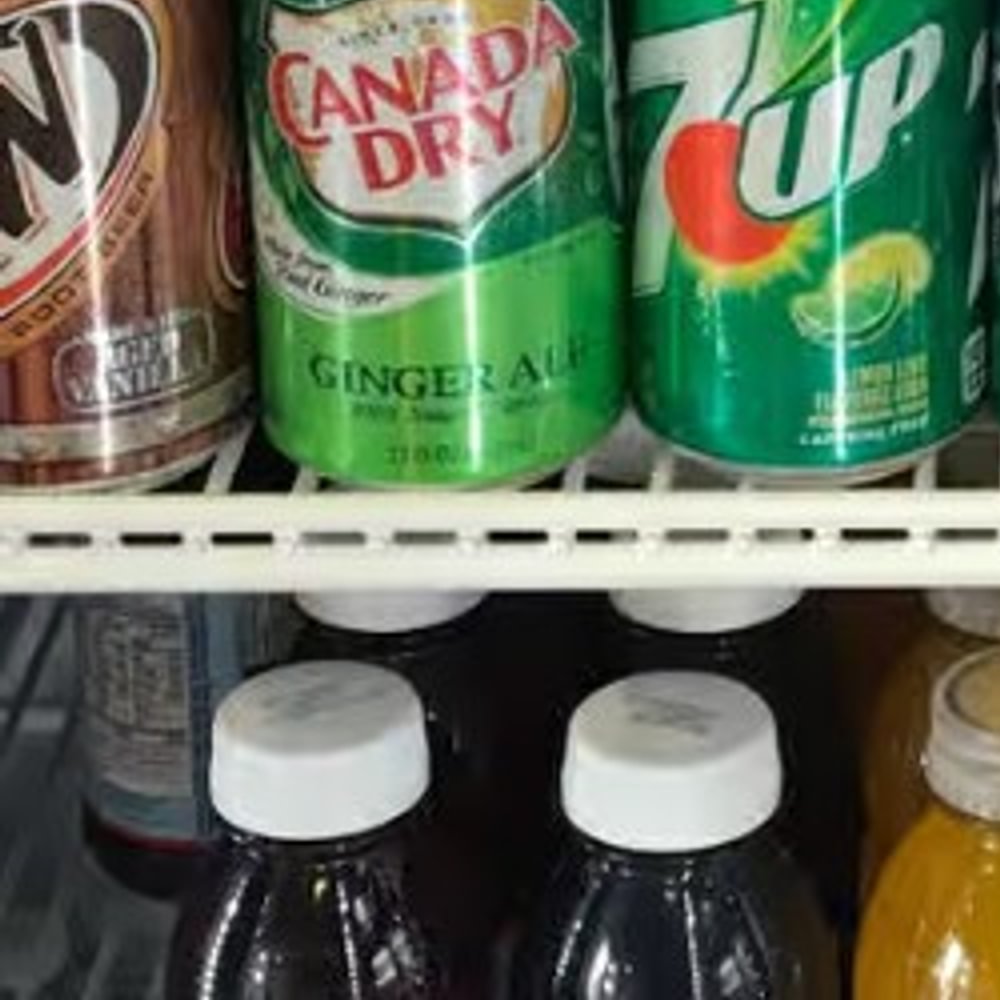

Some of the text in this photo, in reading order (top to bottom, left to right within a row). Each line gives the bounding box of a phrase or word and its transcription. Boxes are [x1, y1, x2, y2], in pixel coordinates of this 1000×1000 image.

[268, 2, 580, 148] CANADA
[354, 89, 515, 193] DRY
[308, 354, 497, 401] GINGER
